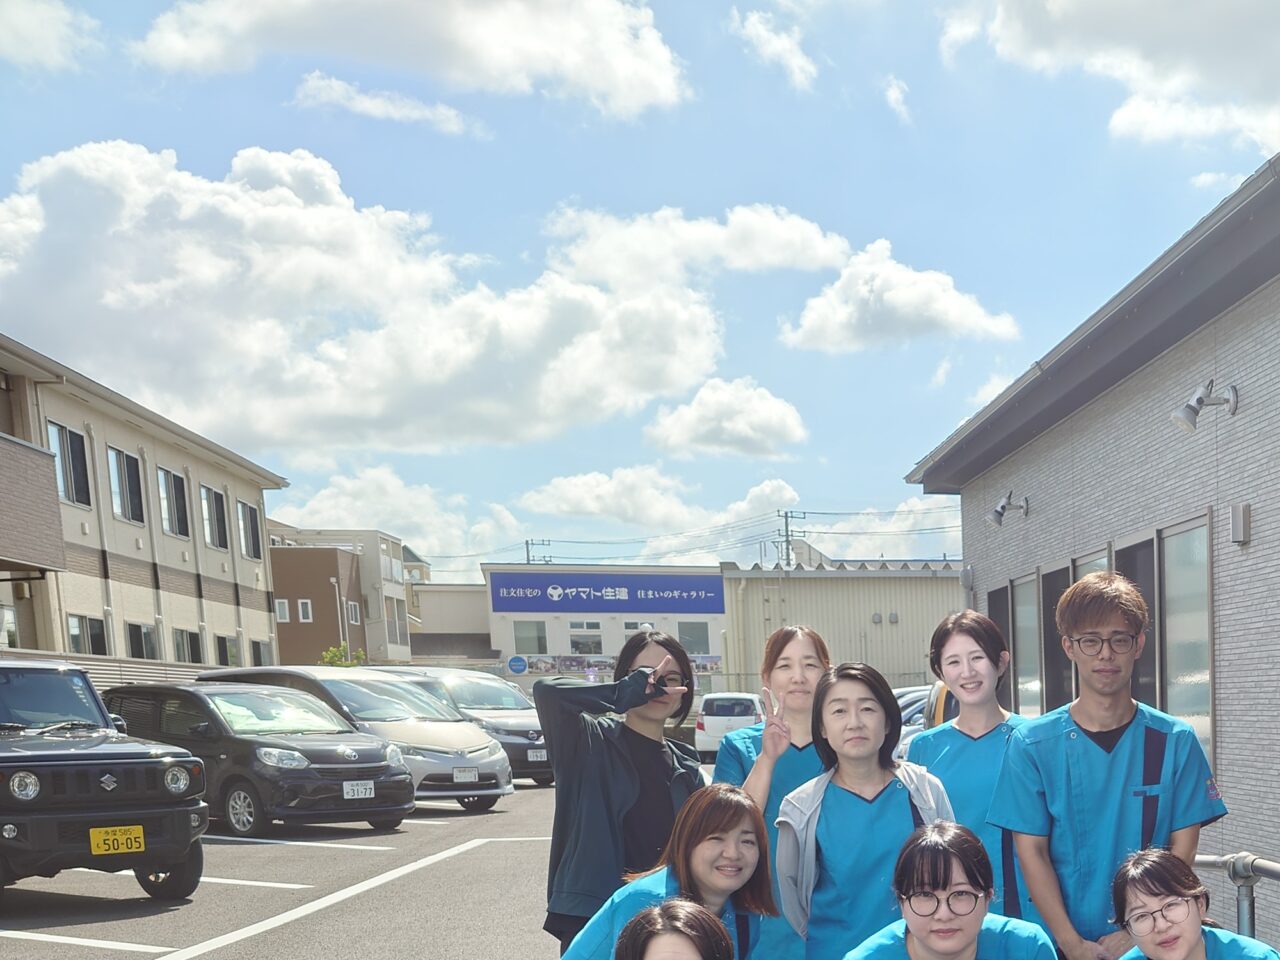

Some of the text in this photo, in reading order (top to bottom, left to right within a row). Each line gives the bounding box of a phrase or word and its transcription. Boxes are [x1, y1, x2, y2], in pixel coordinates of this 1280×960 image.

[499, 587, 715, 600] 注文住宅の ヤマト住建 住まいのギャラリー
[103, 836, 142, 852] 50-05
